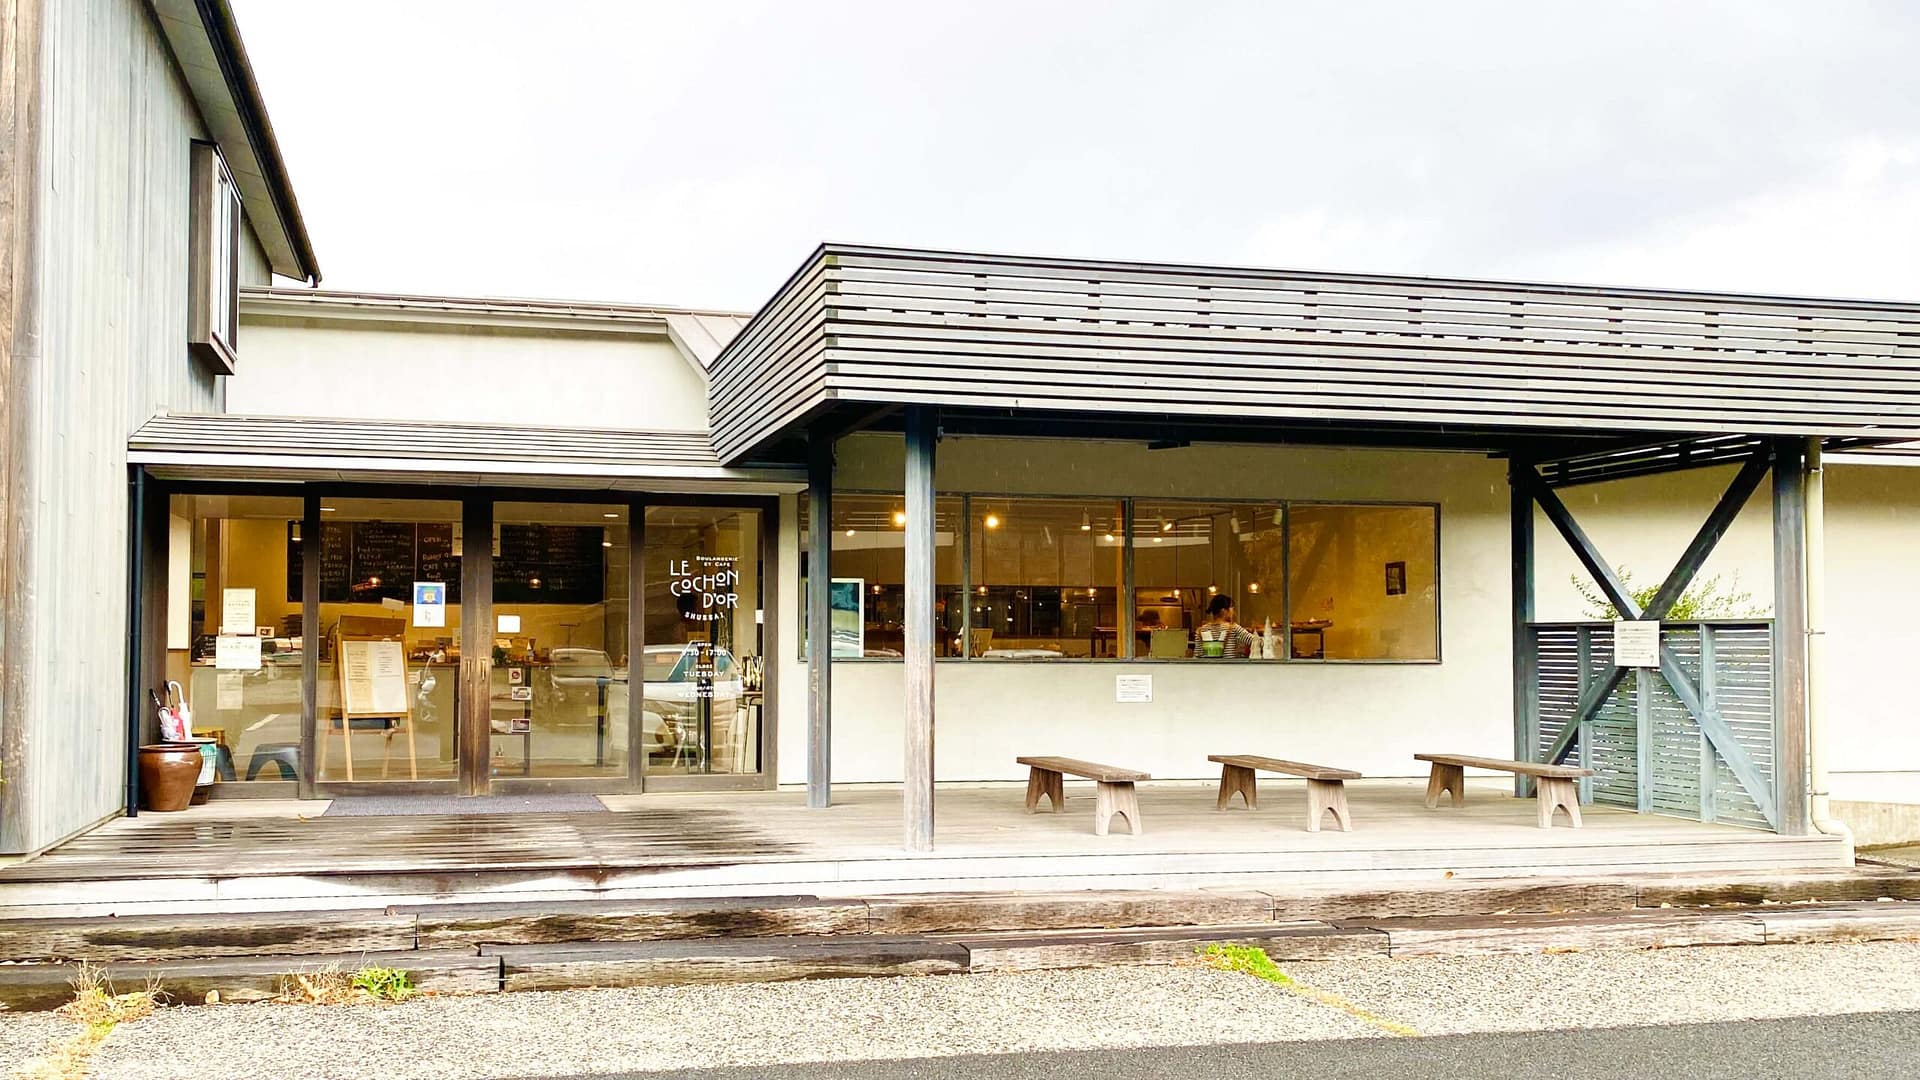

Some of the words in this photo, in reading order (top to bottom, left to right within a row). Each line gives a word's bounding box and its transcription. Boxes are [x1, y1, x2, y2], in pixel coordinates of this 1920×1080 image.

[670, 560, 692, 576] LE
[670, 570, 739, 597] COCHON
[703, 593, 739, 609] D'OR
